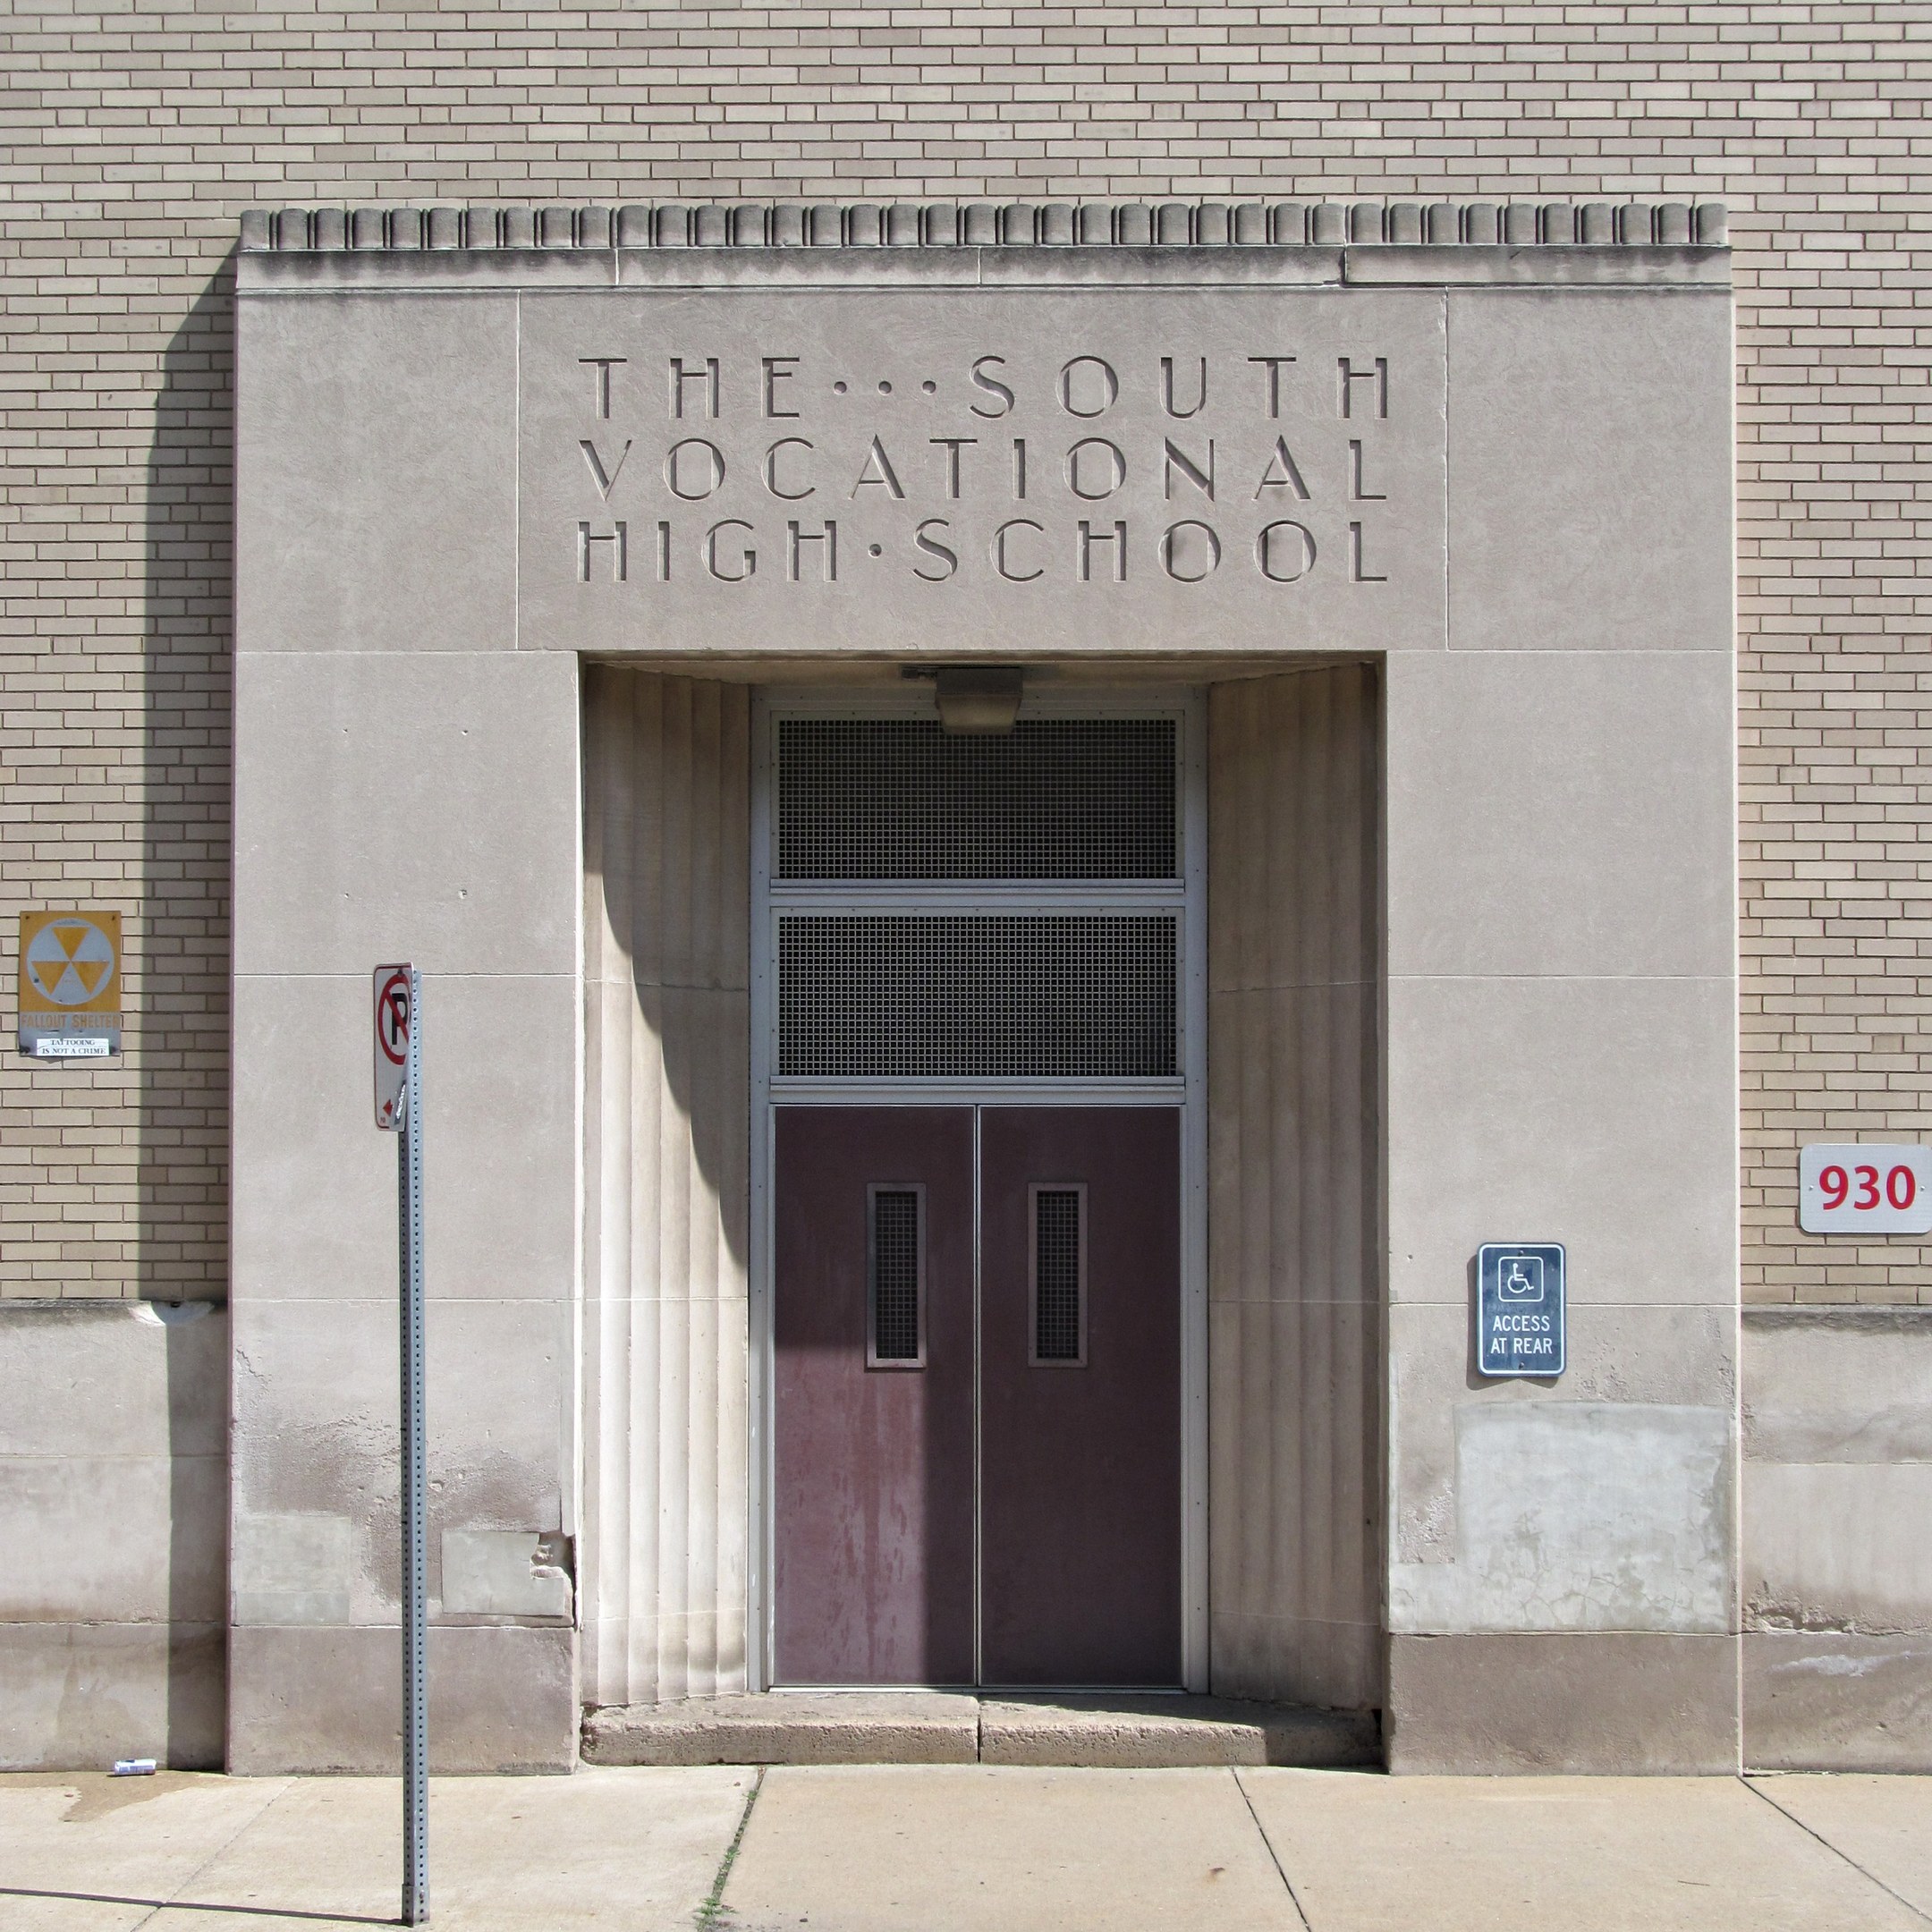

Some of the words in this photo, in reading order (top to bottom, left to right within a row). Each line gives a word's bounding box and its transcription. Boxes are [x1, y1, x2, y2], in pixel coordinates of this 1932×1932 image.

[578, 357, 801, 419] THE
[967, 355, 1387, 419] SOUTH
[578, 434, 1388, 501] VOCATIONAL
[577, 519, 837, 583] HIGH
[912, 518, 1388, 584] SCHOOL
[21, 1014, 67, 1029] FALLOUT
[72, 1014, 121, 1029] SHELTER
[1818, 1165, 1917, 1211] 930
[1490, 1337, 1508, 1355] AT
[1513, 1337, 1554, 1355] REAR
[1492, 1315, 1551, 1333] ACCESS
